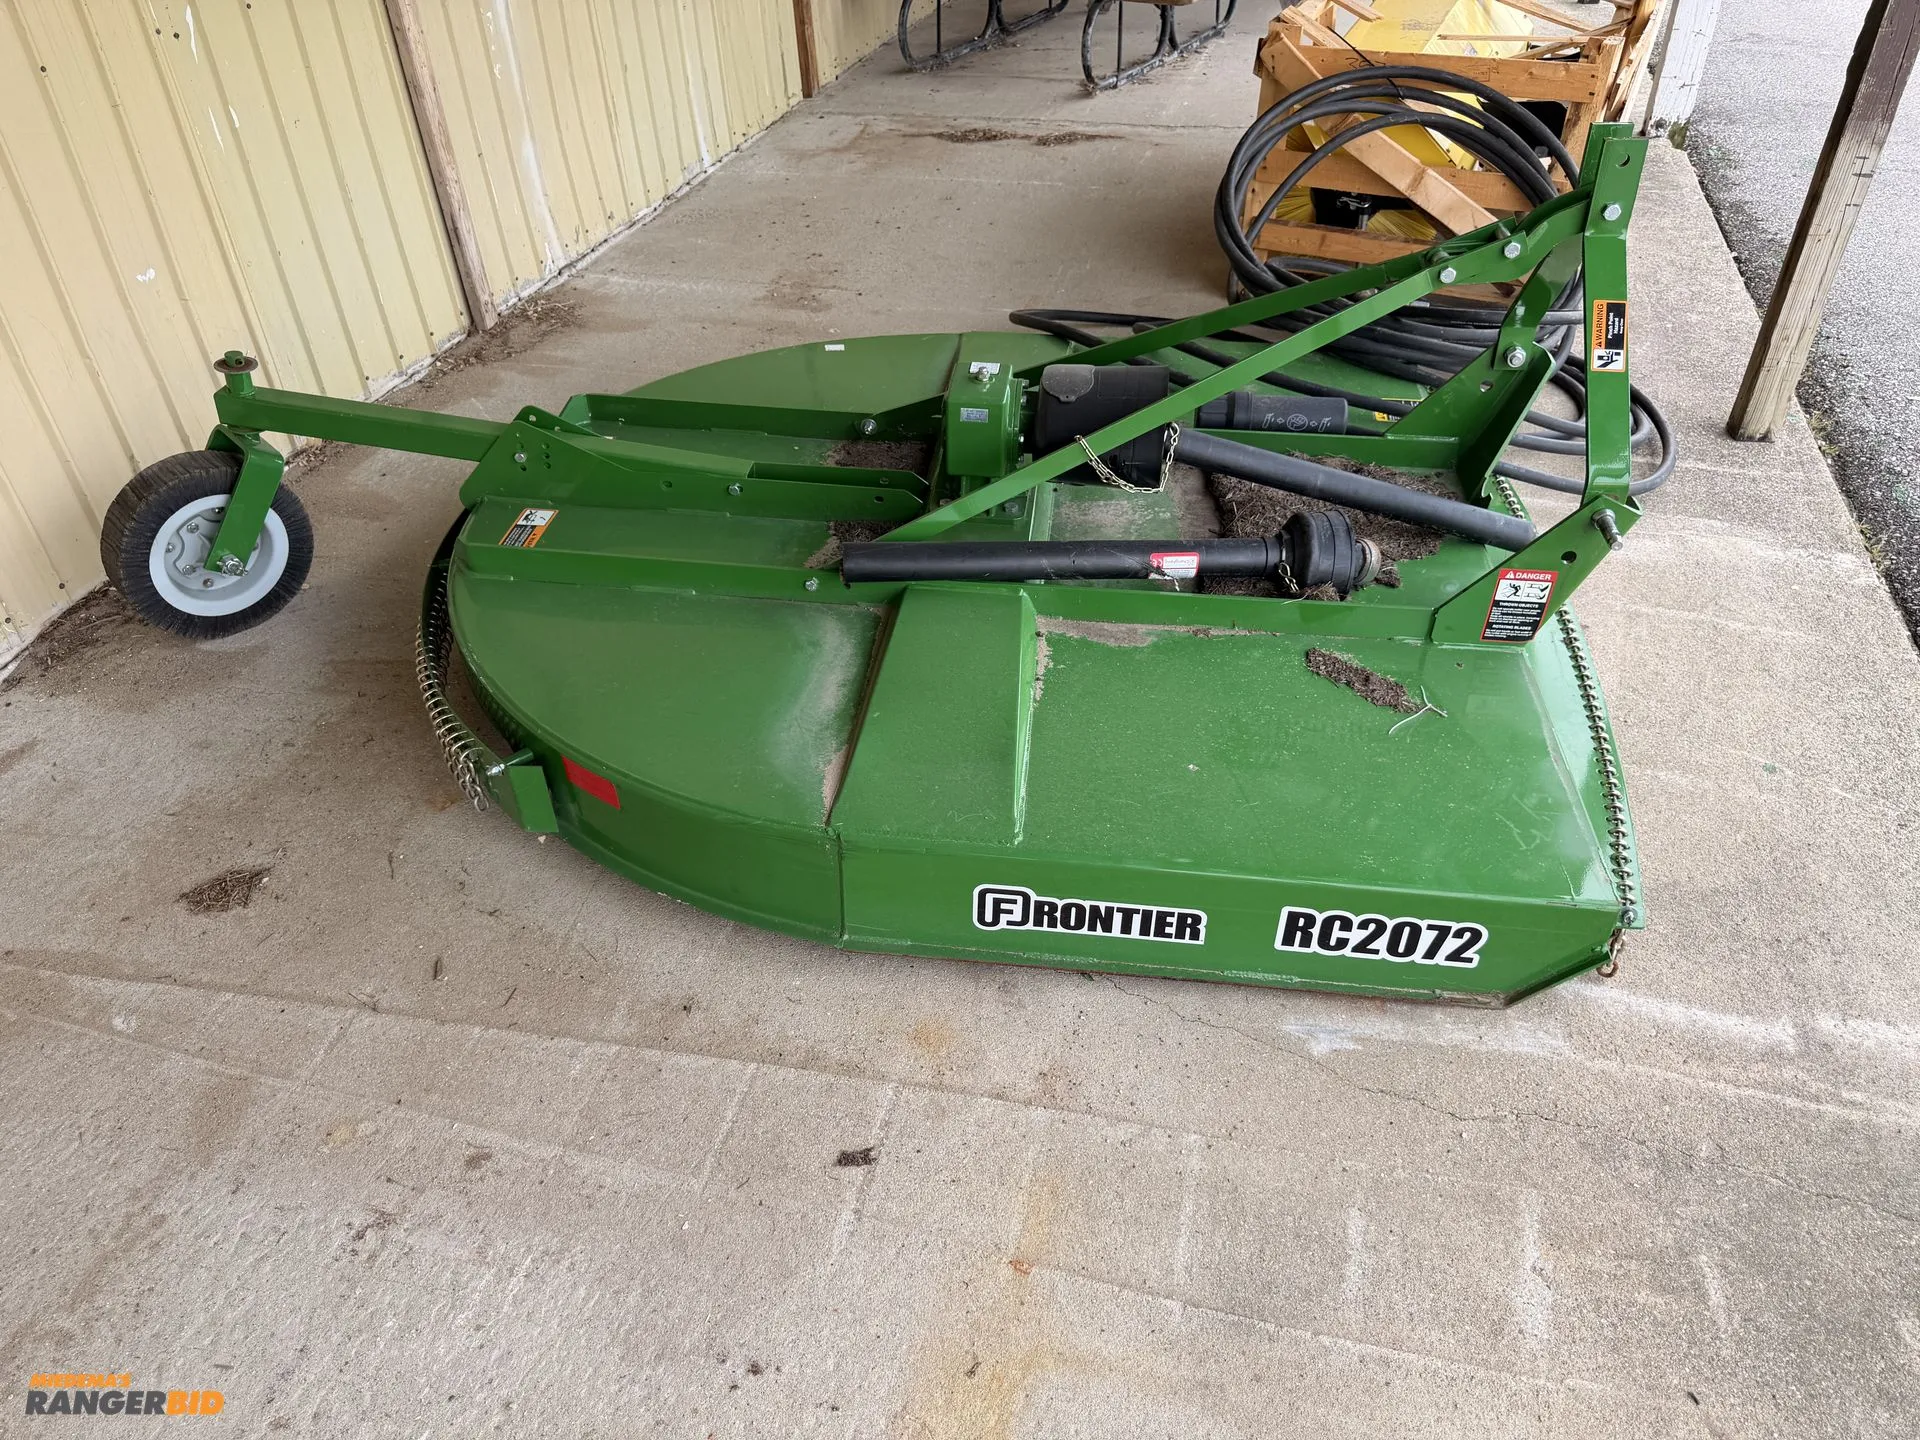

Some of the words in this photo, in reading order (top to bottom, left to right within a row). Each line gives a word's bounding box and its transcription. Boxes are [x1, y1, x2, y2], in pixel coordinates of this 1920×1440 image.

[1595, 304, 1604, 341] WARNING
[1515, 572, 1552, 580] DANGER
[976, 887, 1204, 942] FRONTIER
[1281, 910, 1483, 964] RC2072
